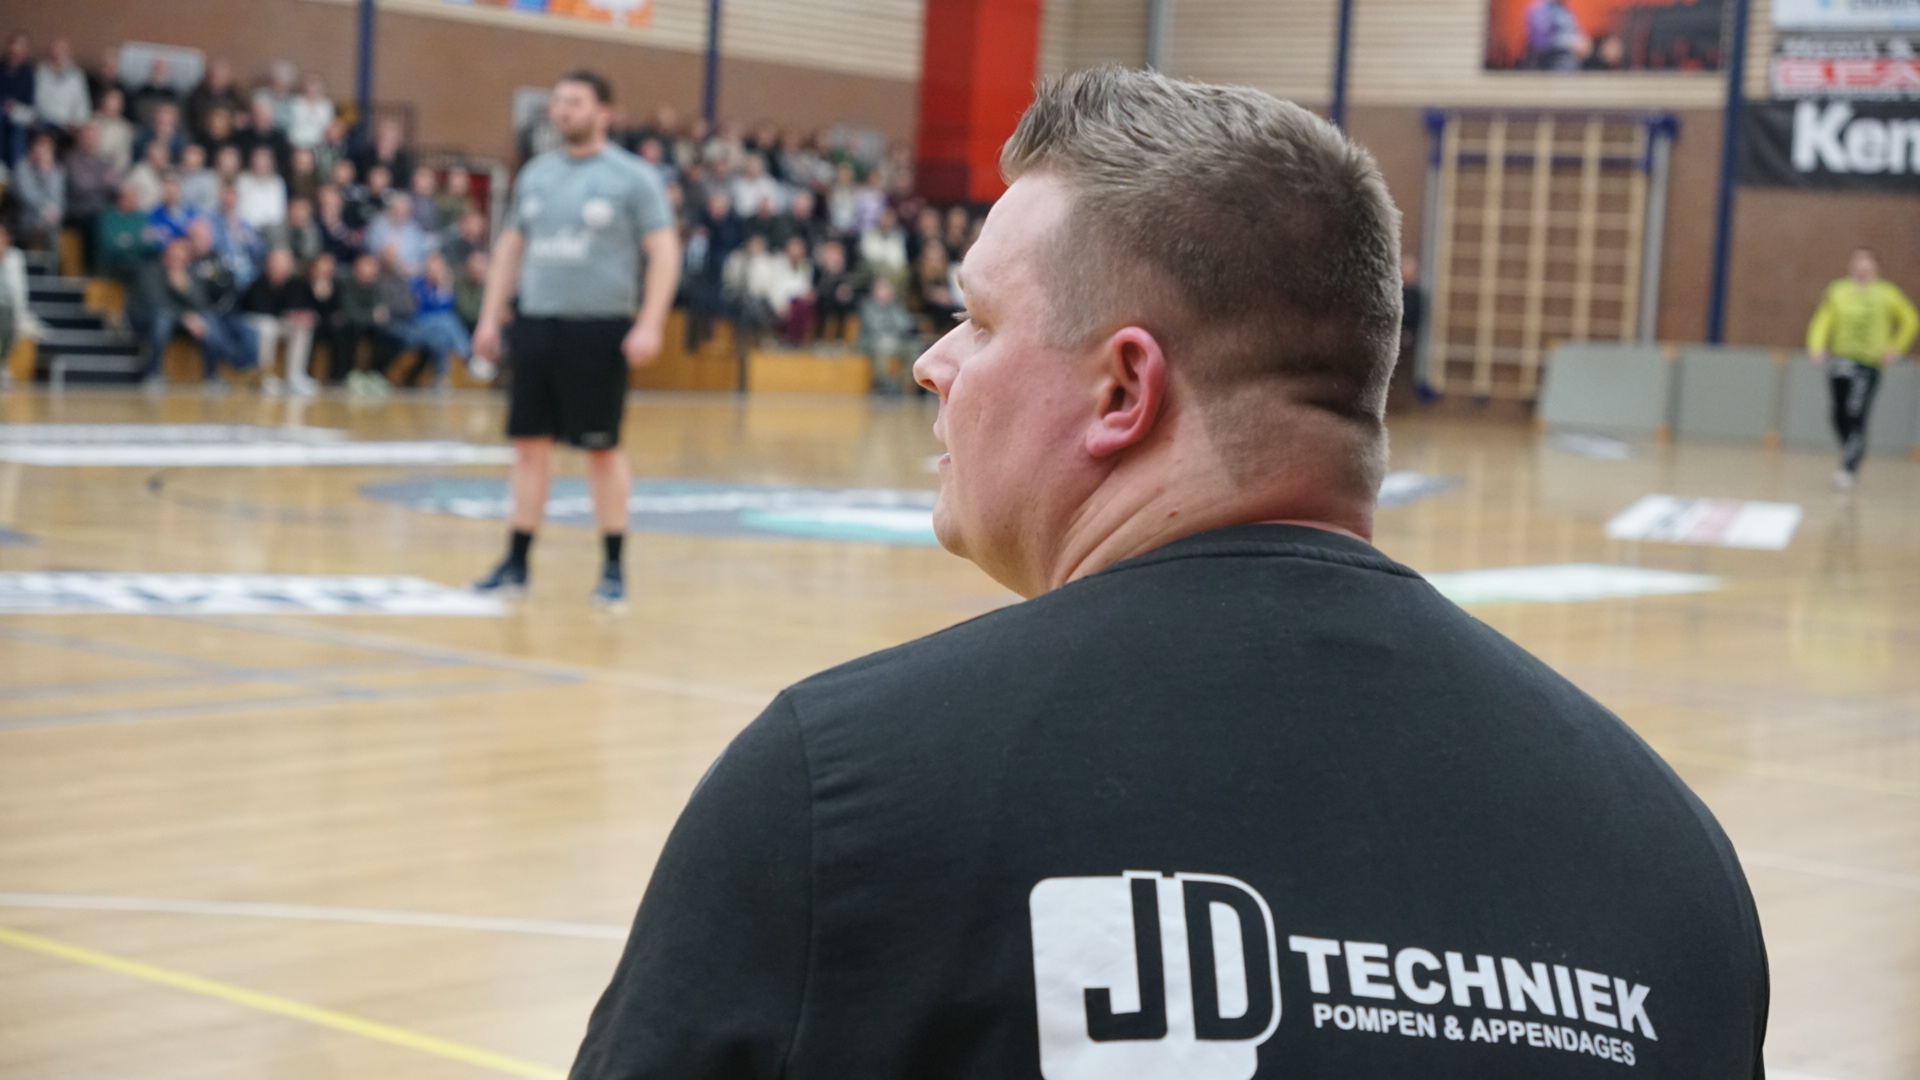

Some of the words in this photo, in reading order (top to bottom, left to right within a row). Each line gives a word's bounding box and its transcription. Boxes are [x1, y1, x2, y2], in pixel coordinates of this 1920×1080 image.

[1083, 874, 1278, 1044] JD
[1289, 934, 1658, 1041] TECHNIEK
[1312, 1003, 1437, 1038] POMPEN
[1443, 1015, 1465, 1041] &
[1469, 1017, 1636, 1066] APPENDAGES
